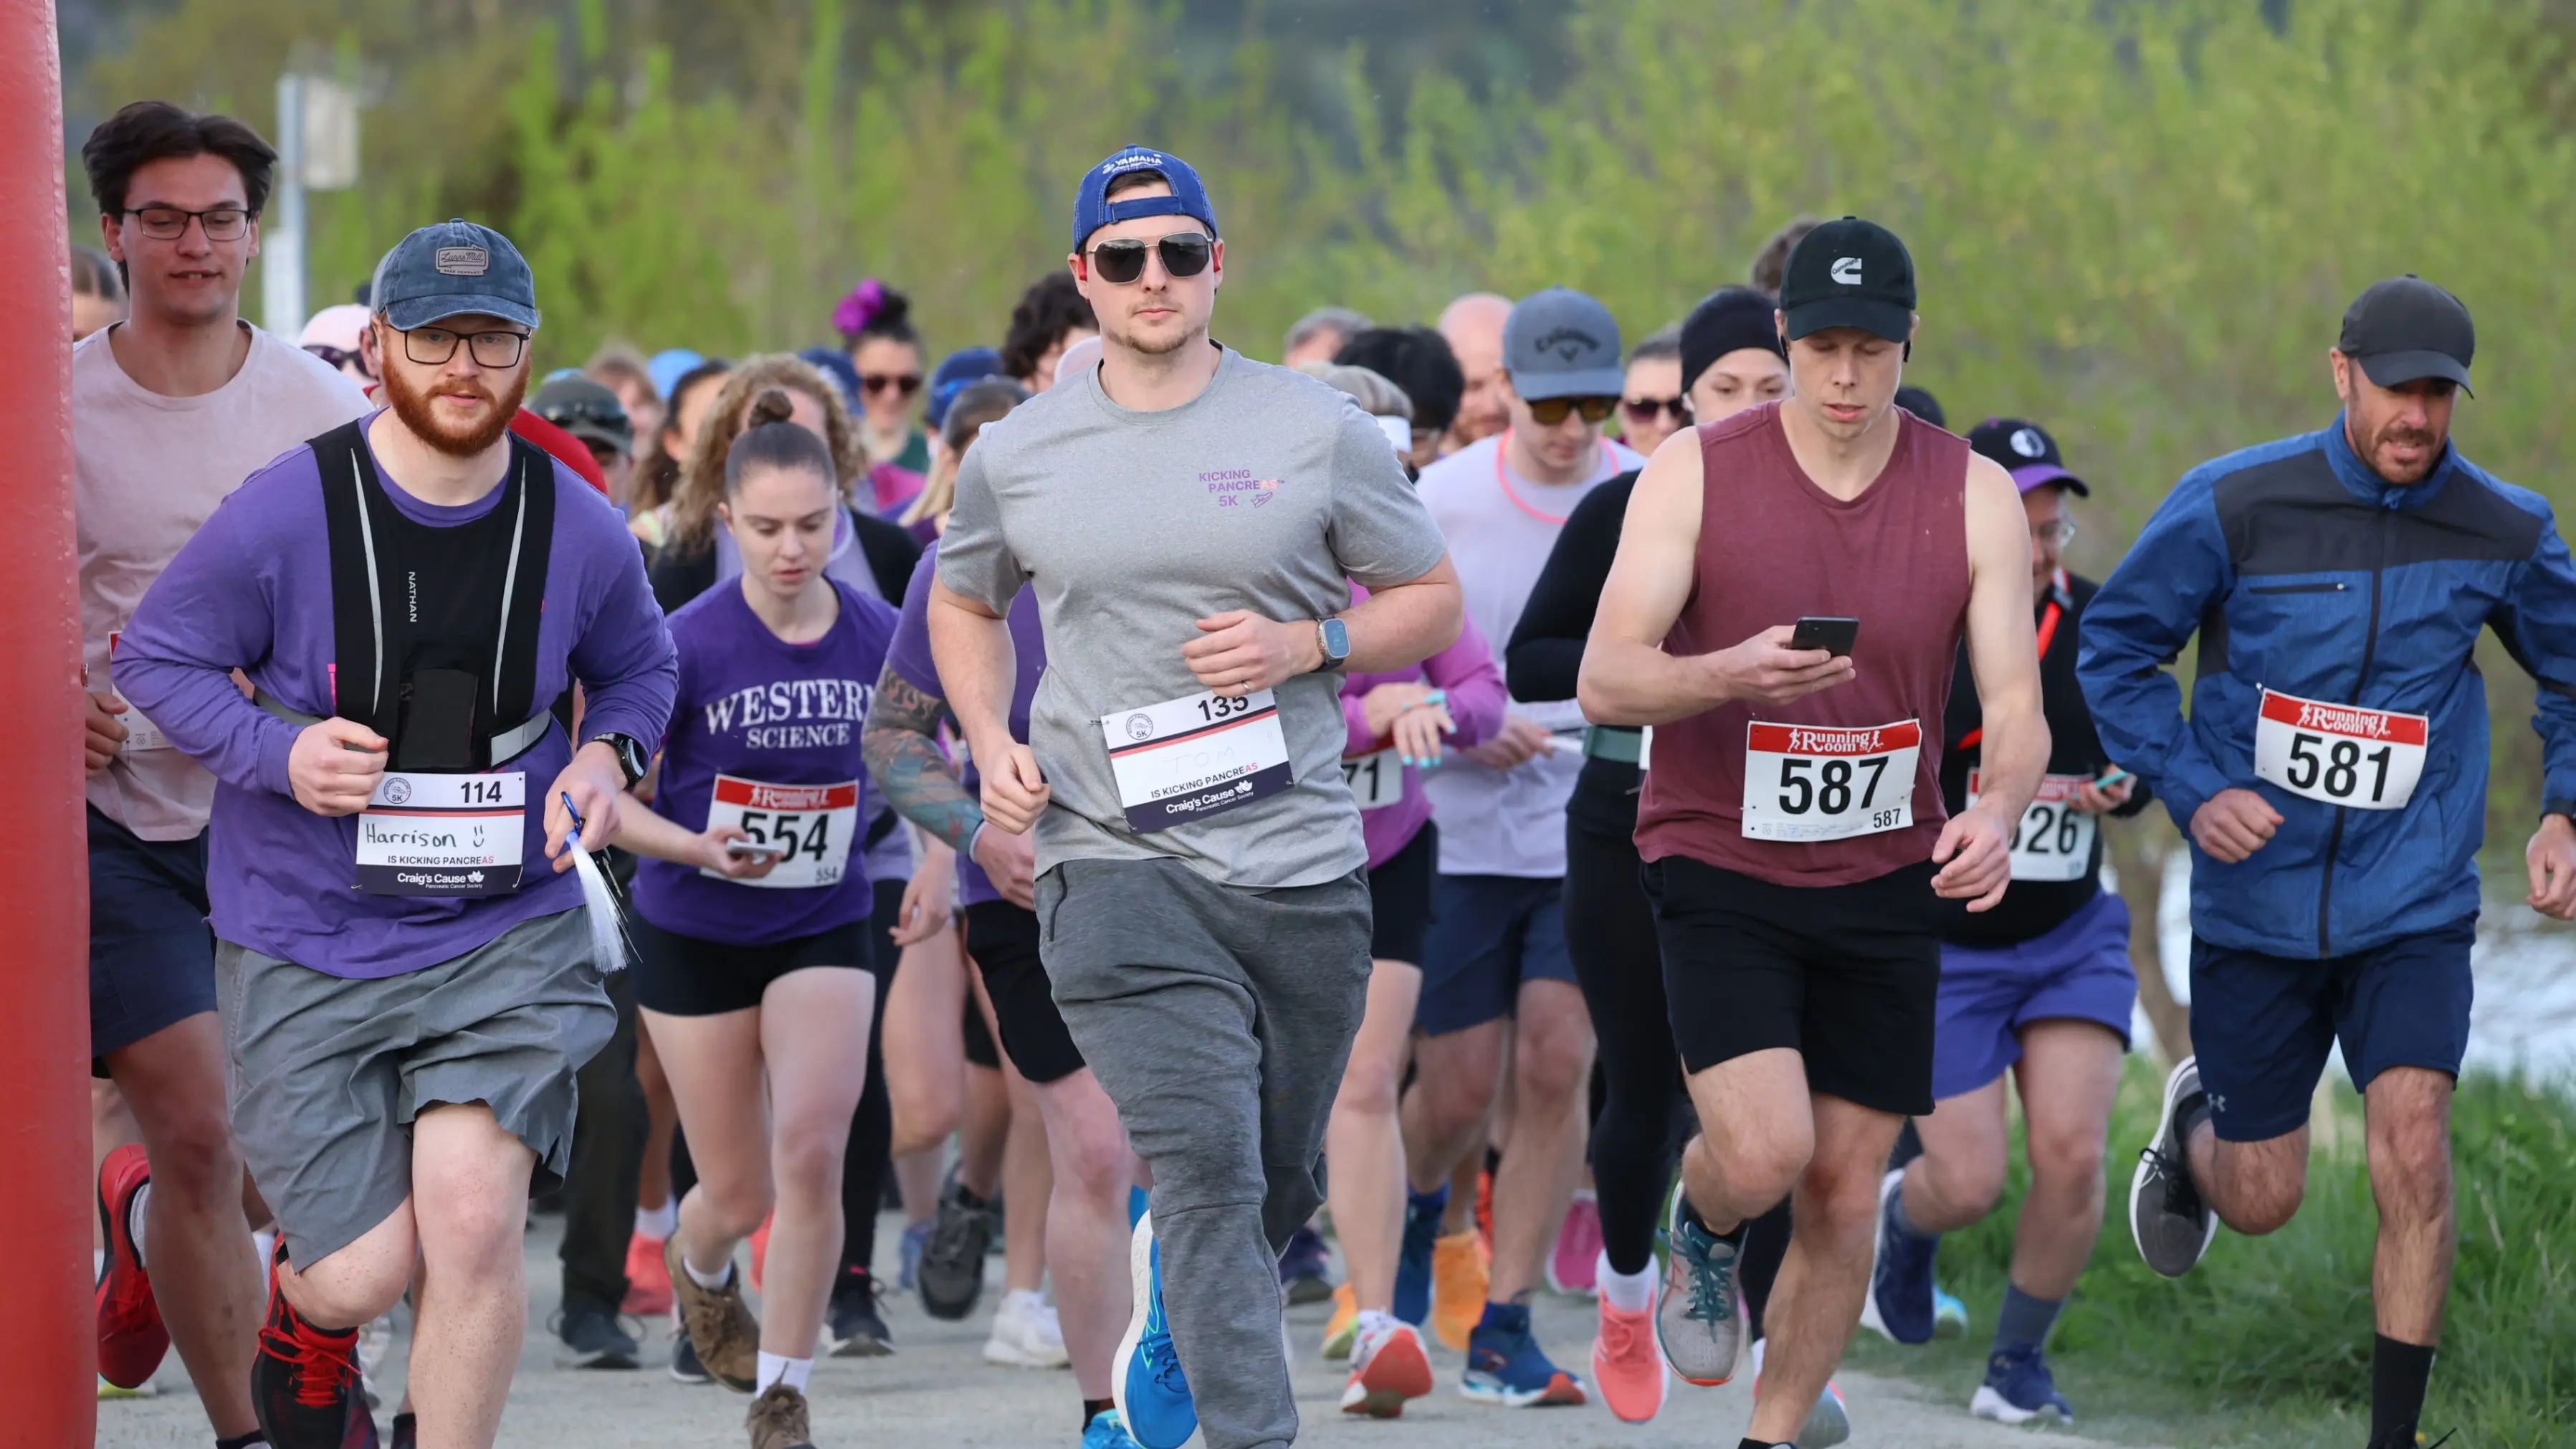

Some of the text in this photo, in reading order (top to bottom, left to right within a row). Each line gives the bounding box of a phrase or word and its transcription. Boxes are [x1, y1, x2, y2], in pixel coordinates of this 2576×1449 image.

[1115, 156, 1163, 166] YAMAHA
[1199, 470, 1251, 483] KICKING
[1219, 495, 1238, 507] 5K
[409, 571, 417, 622] NATHAN
[1198, 695, 1249, 721] 135
[2311, 707, 2379, 734] Running
[746, 723, 851, 749] SCIENCE
[1801, 731, 1871, 752] Running
[2287, 732, 2392, 802] 581
[460, 781, 502, 804] 114
[1150, 762, 1259, 799] IS KICKING PANCREAS
[1779, 756, 1889, 814] 587
[1165, 789, 1236, 814] Craig's Cause
[1196, 791, 1254, 812] Pancreatic Cancer Society
[1873, 808, 1902, 829] 587
[2010, 806, 2077, 855] 26
[366, 822, 457, 848] Harrison
[740, 811, 829, 863] 554
[388, 855, 494, 865] IS KICKING PANCREAS
[397, 873, 467, 885] Craig's Cause
[815, 867, 838, 883] 554
